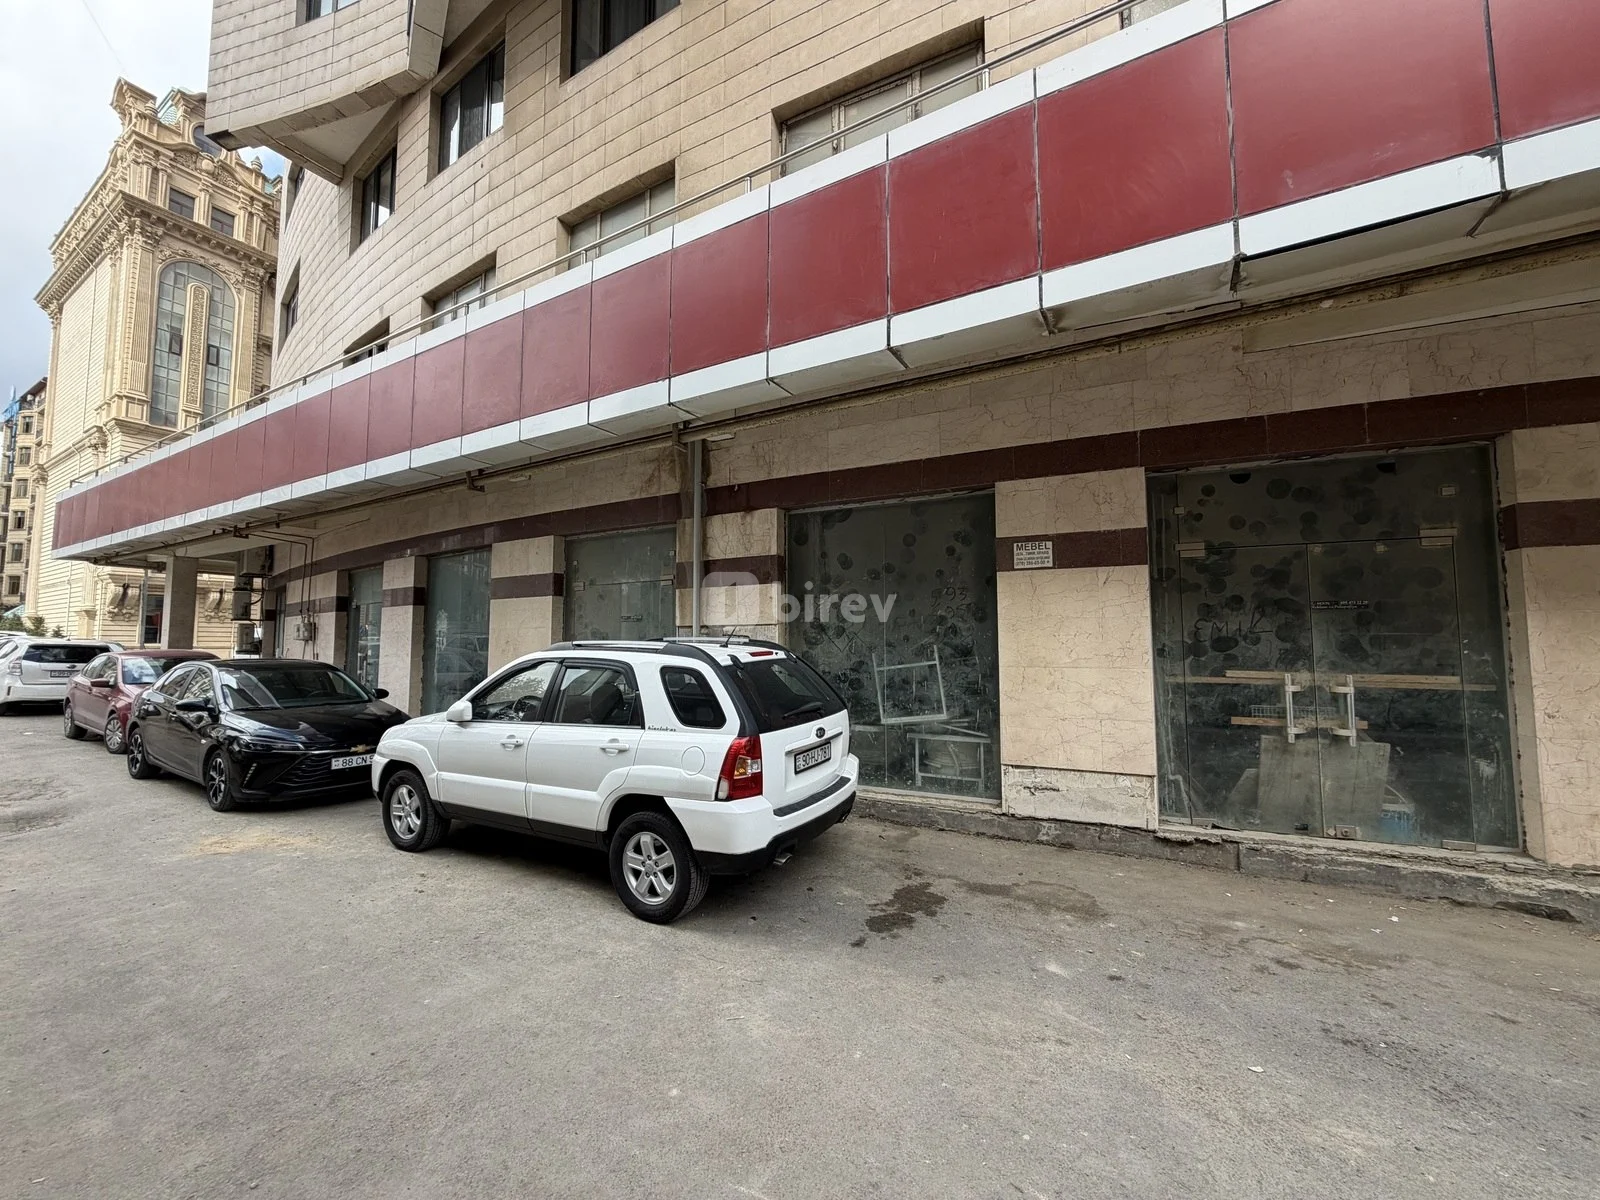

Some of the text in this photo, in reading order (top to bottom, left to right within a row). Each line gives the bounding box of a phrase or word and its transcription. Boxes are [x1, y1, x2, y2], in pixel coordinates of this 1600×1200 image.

[1016, 541, 1051, 551] MEBEL
[342, 758, 354, 767] 88
[356, 756, 368, 765] CN
